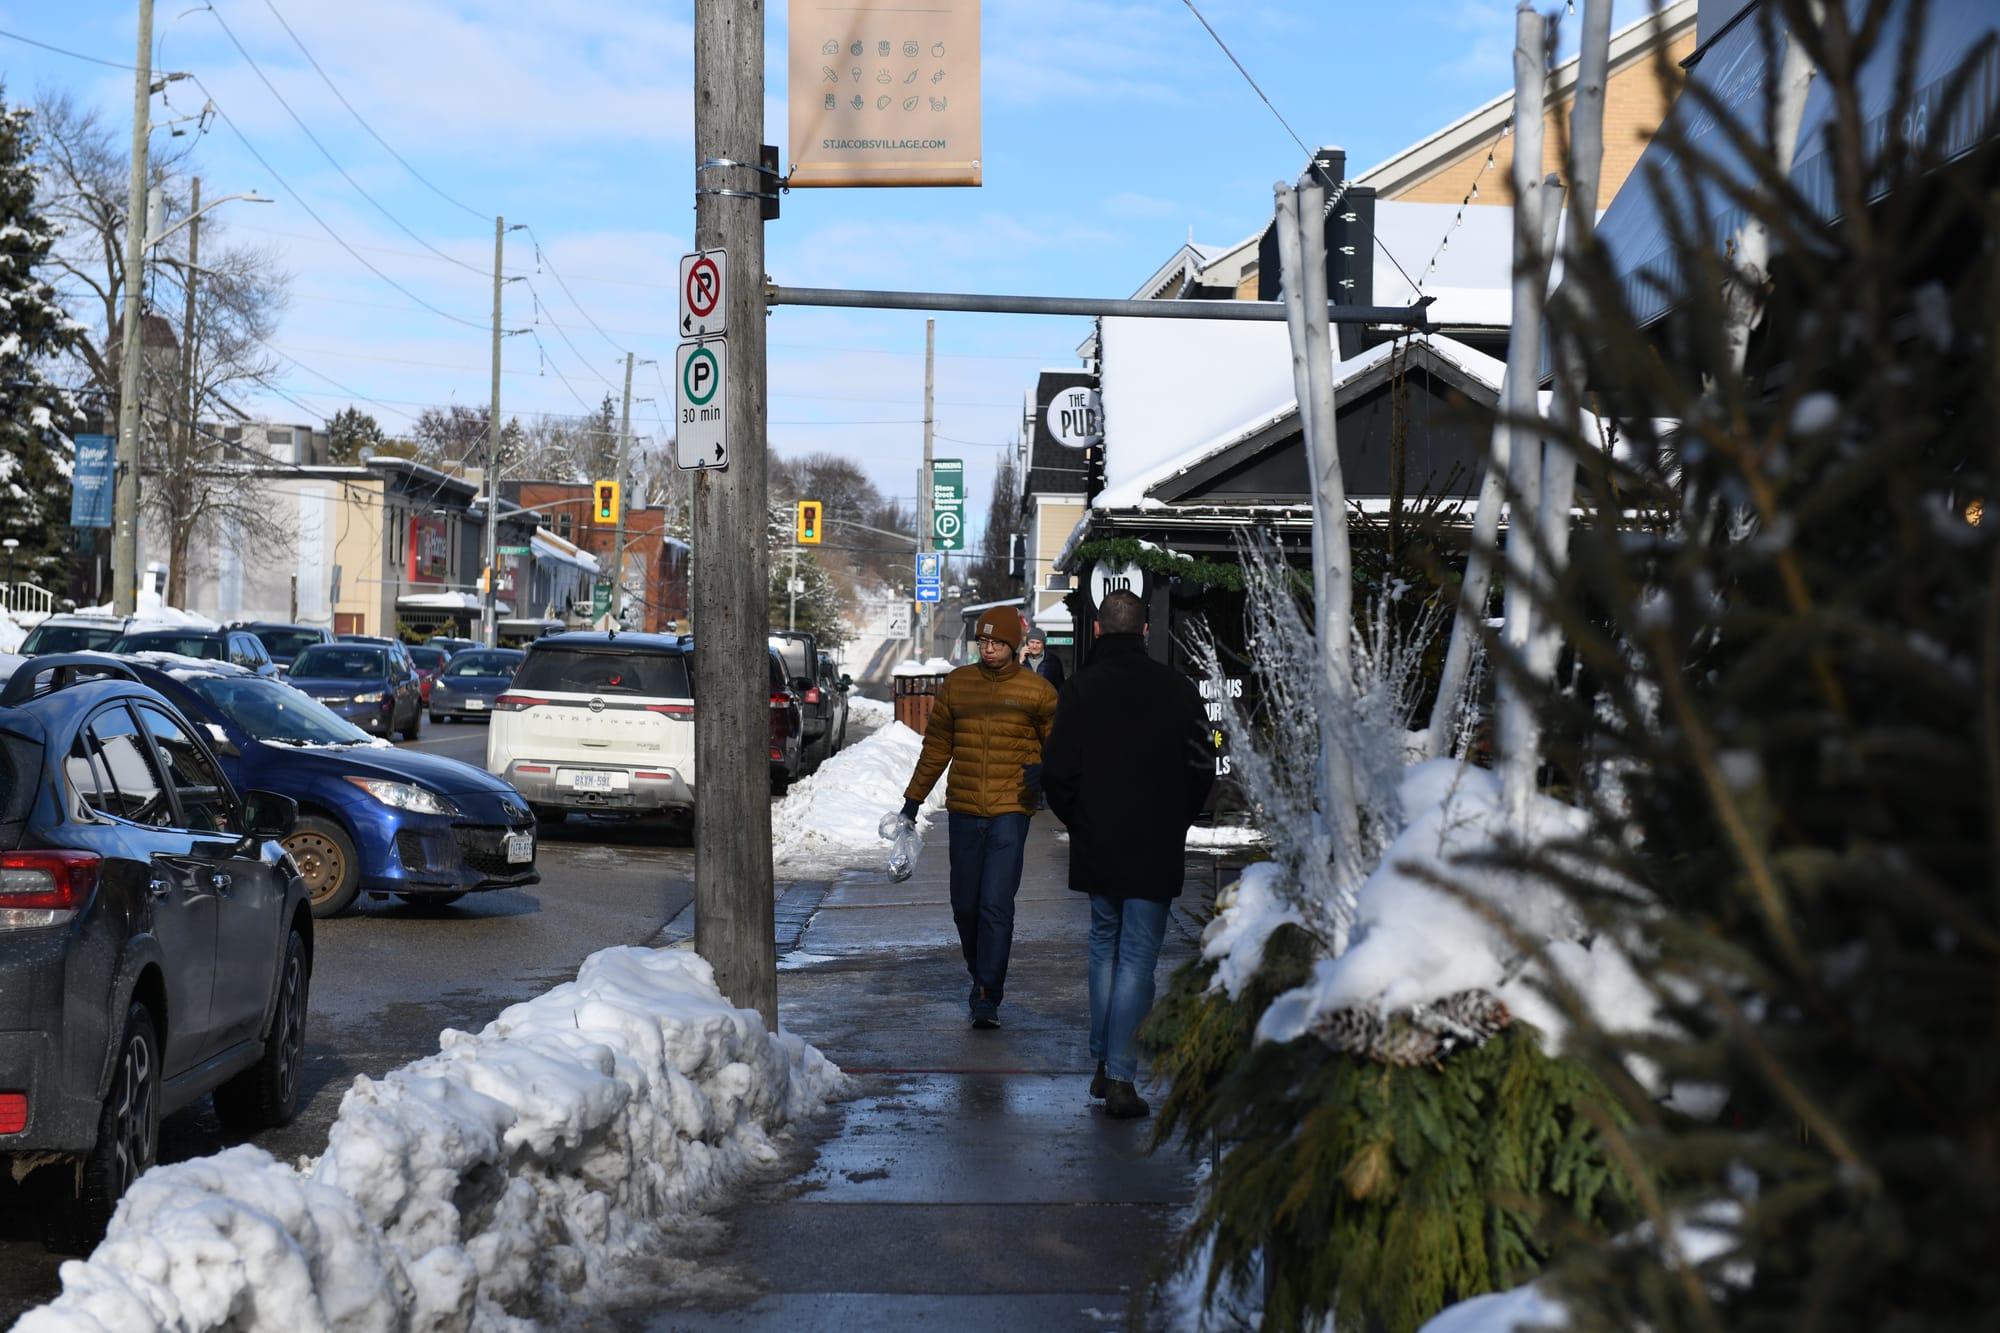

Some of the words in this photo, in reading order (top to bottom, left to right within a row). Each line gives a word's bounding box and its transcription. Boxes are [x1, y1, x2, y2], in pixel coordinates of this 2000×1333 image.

[823, 139, 946, 149] STJACOBSVILLAGE.COM
[694, 363, 710, 391] P
[1068, 394, 1086, 407] THE
[683, 408, 695, 423] 30
[701, 405, 720, 421] min
[1061, 409, 1097, 438] PUB
[943, 517, 955, 533] P
[1227, 679, 1242, 698] US
[532, 712, 661, 727] PATHFINDER
